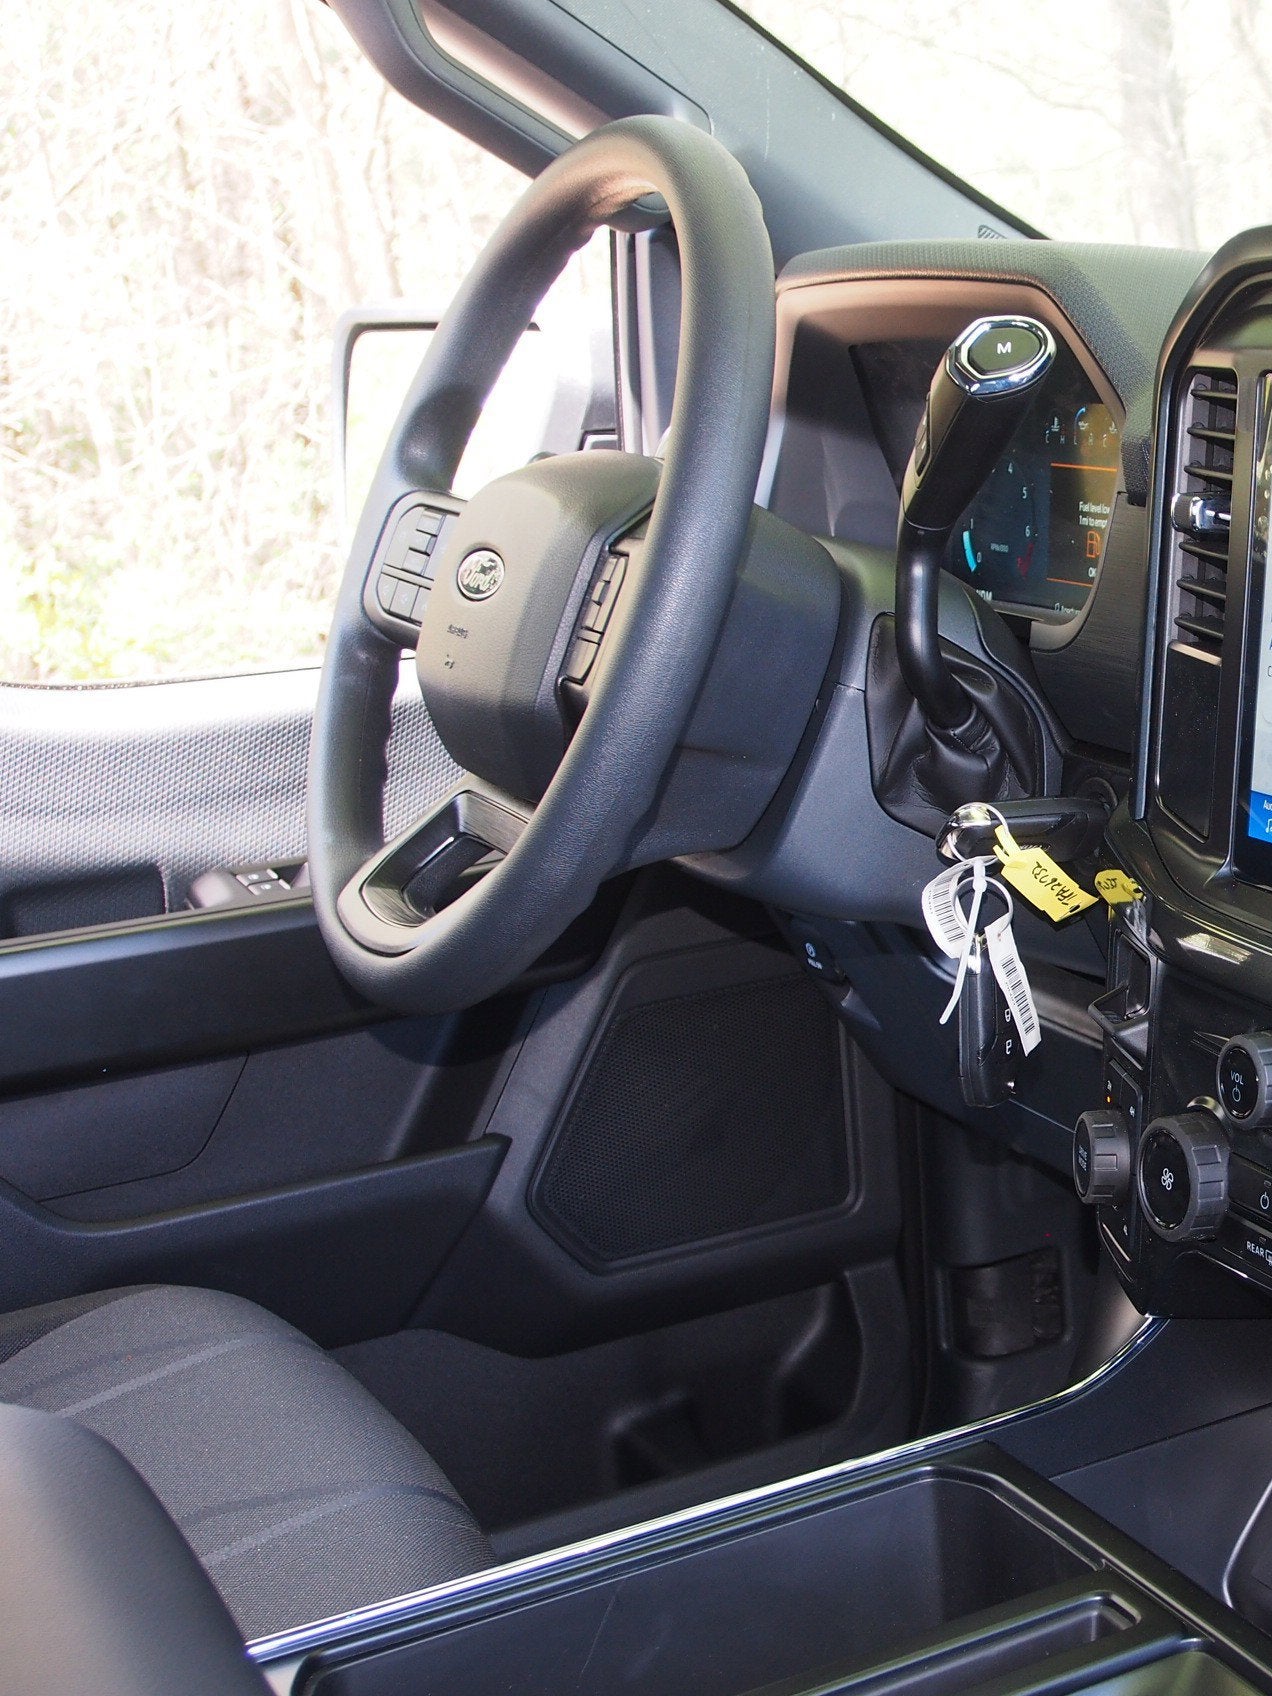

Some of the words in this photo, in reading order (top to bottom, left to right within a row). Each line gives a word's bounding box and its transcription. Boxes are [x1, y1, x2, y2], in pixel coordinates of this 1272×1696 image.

[996, 342, 1012, 354] M
[1008, 462, 1013, 474] 4
[1022, 487, 1028, 499] 5
[1025, 525, 1031, 537] 6
[1230, 1070, 1244, 1086] VOL
[1246, 1241, 1265, 1258] REAR
